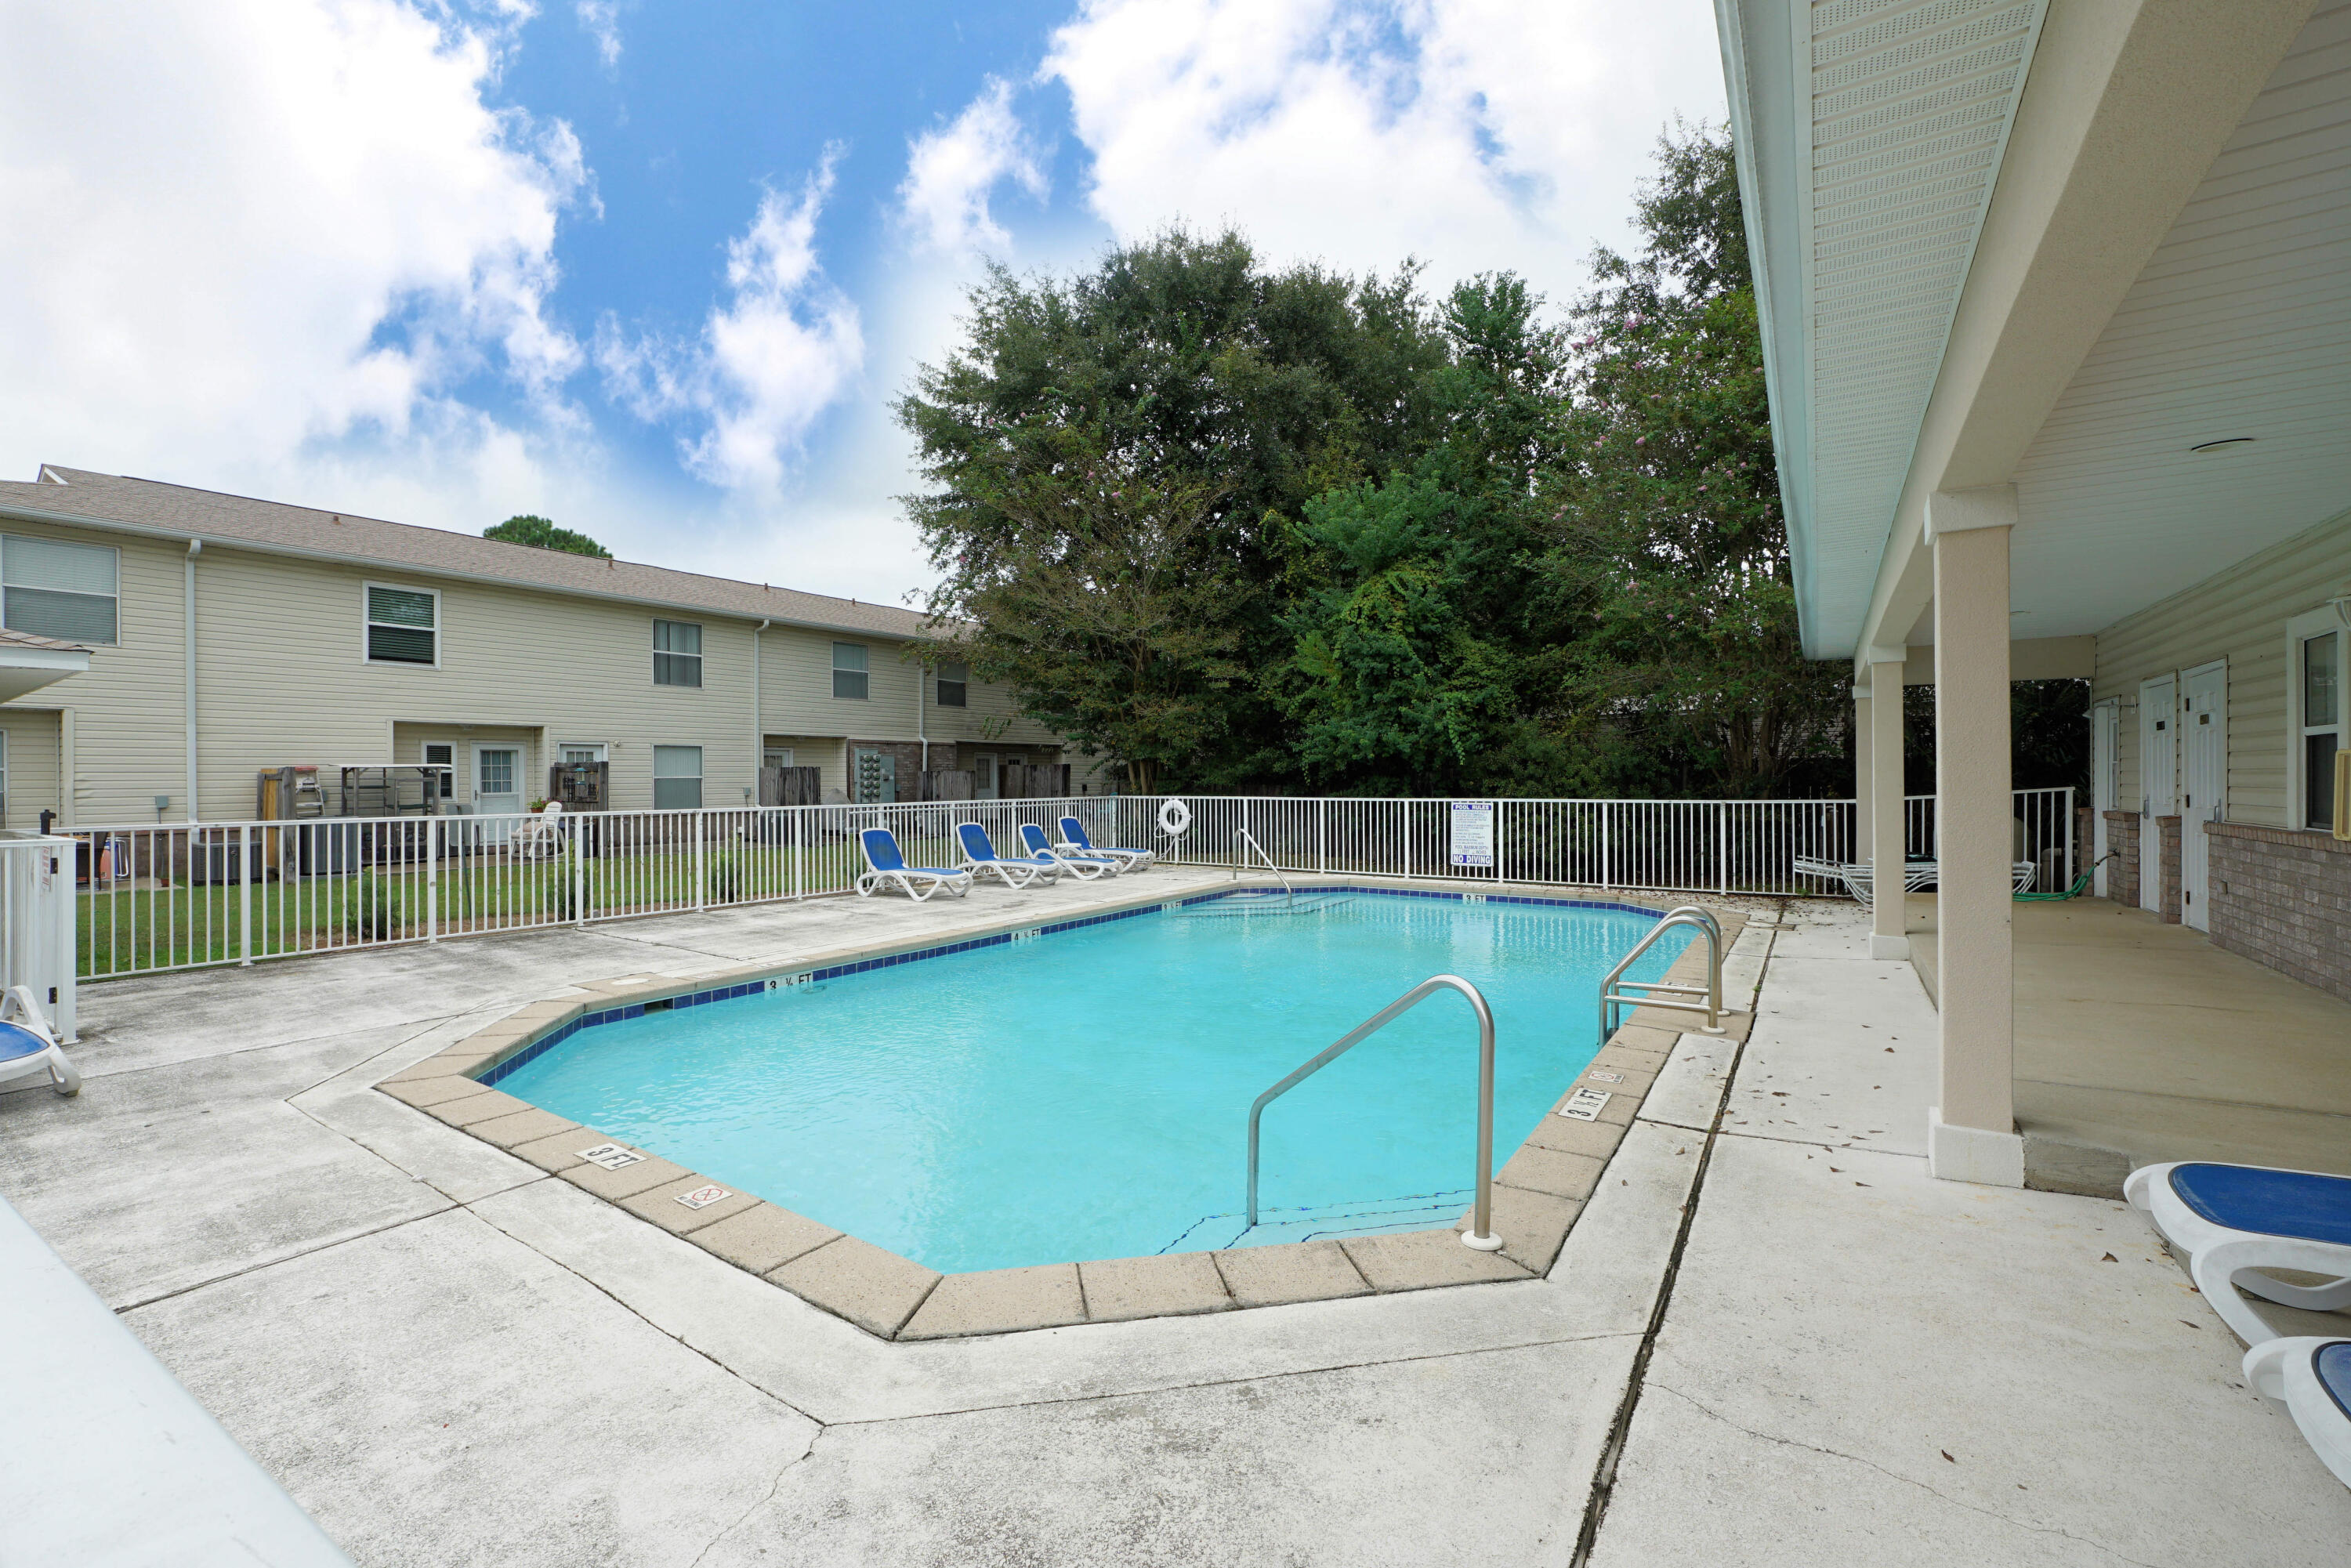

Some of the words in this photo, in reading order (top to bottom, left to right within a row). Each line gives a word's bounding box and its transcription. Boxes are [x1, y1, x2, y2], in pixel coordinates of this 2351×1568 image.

[1453, 854, 1463, 863] NO
[1466, 855, 1491, 864] DIVING
[770, 980, 777, 990] 3
[799, 973, 811, 984] FT
[587, 1147, 614, 1157] 3
